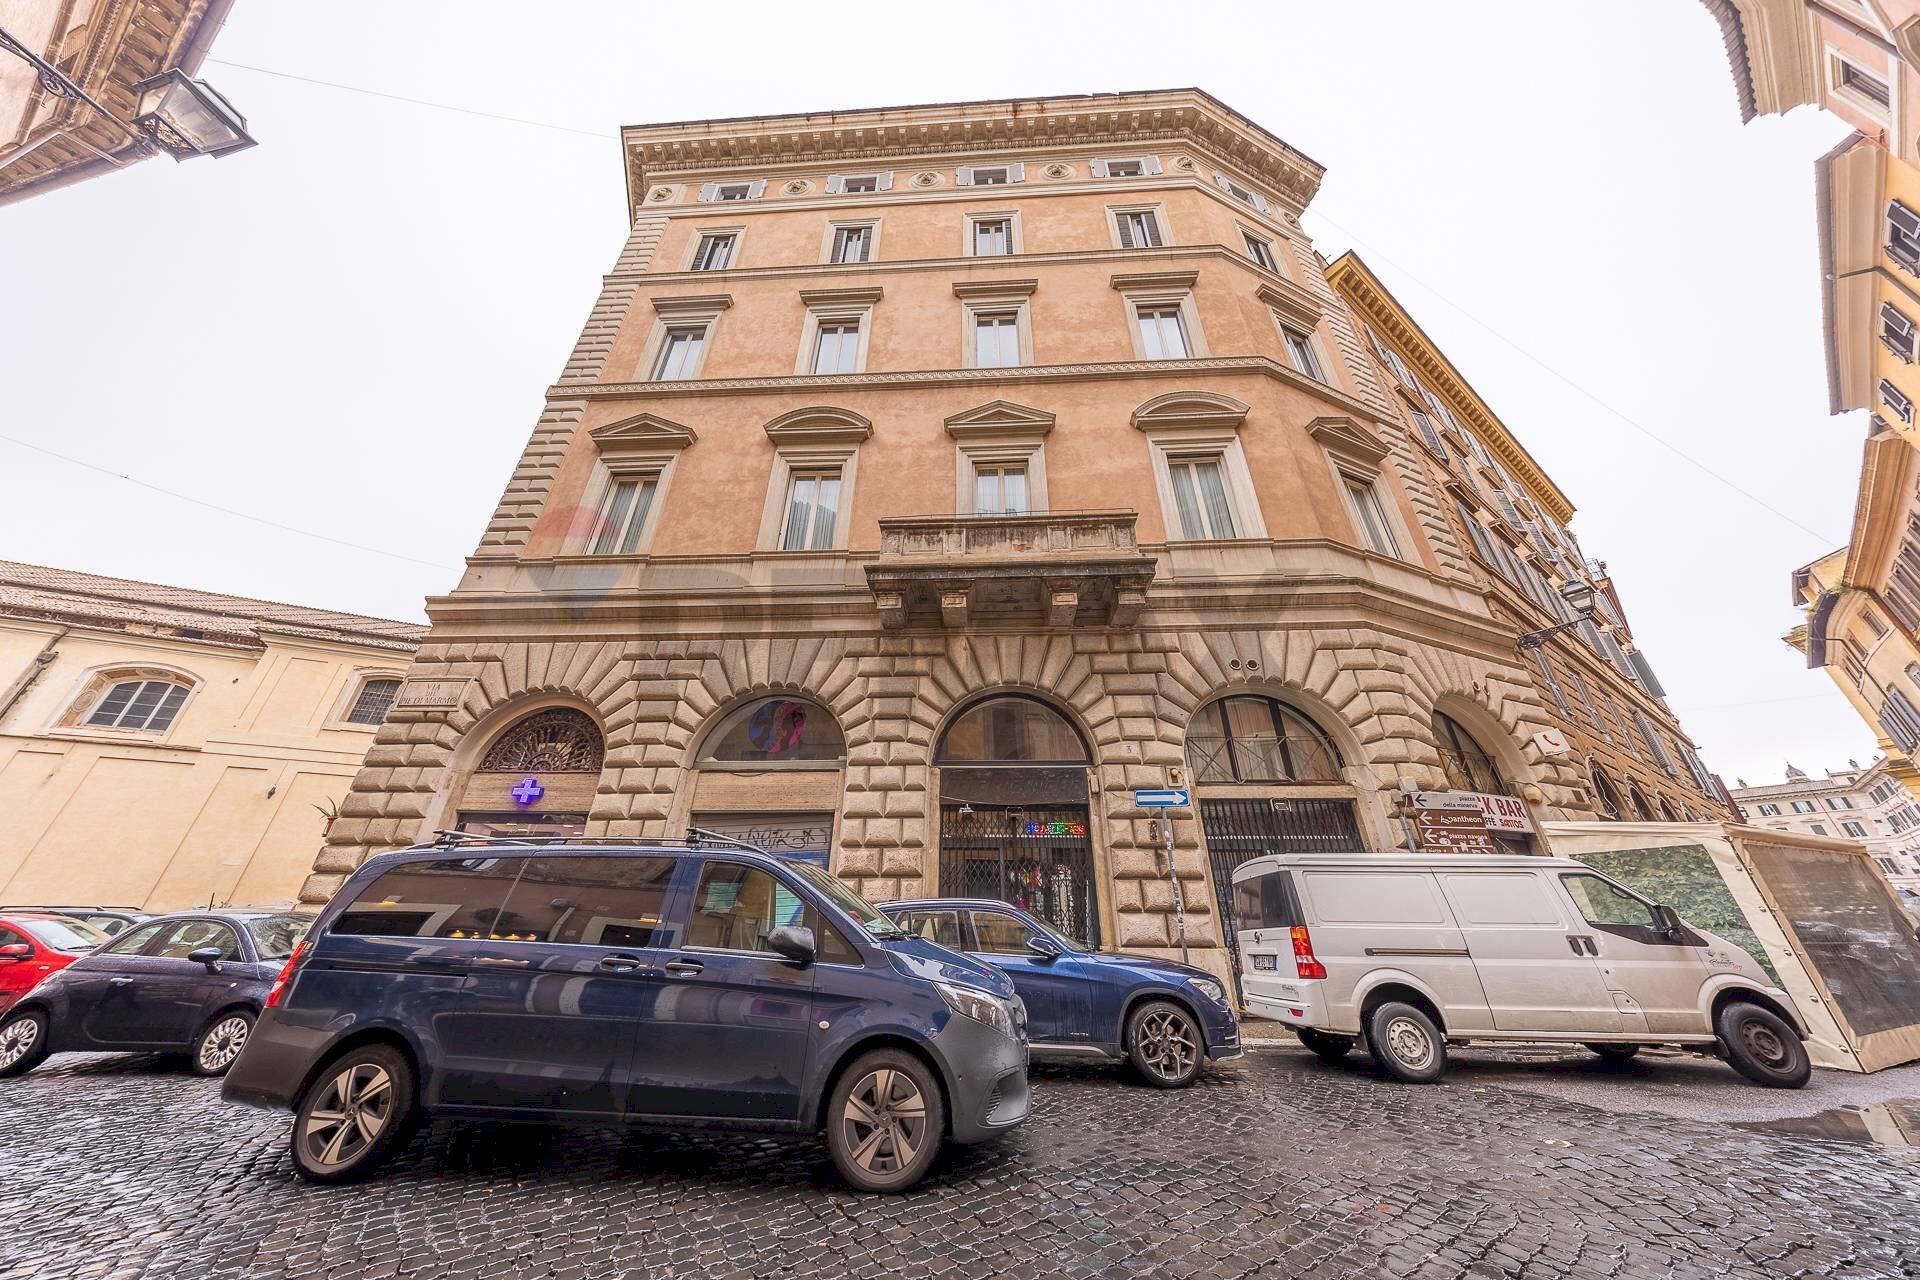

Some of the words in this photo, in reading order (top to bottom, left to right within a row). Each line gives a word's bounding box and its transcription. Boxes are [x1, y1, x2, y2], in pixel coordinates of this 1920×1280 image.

[425, 696, 458, 704] MARMO
[1495, 798, 1527, 818] BAR
[1448, 815, 1482, 825] pantheon
